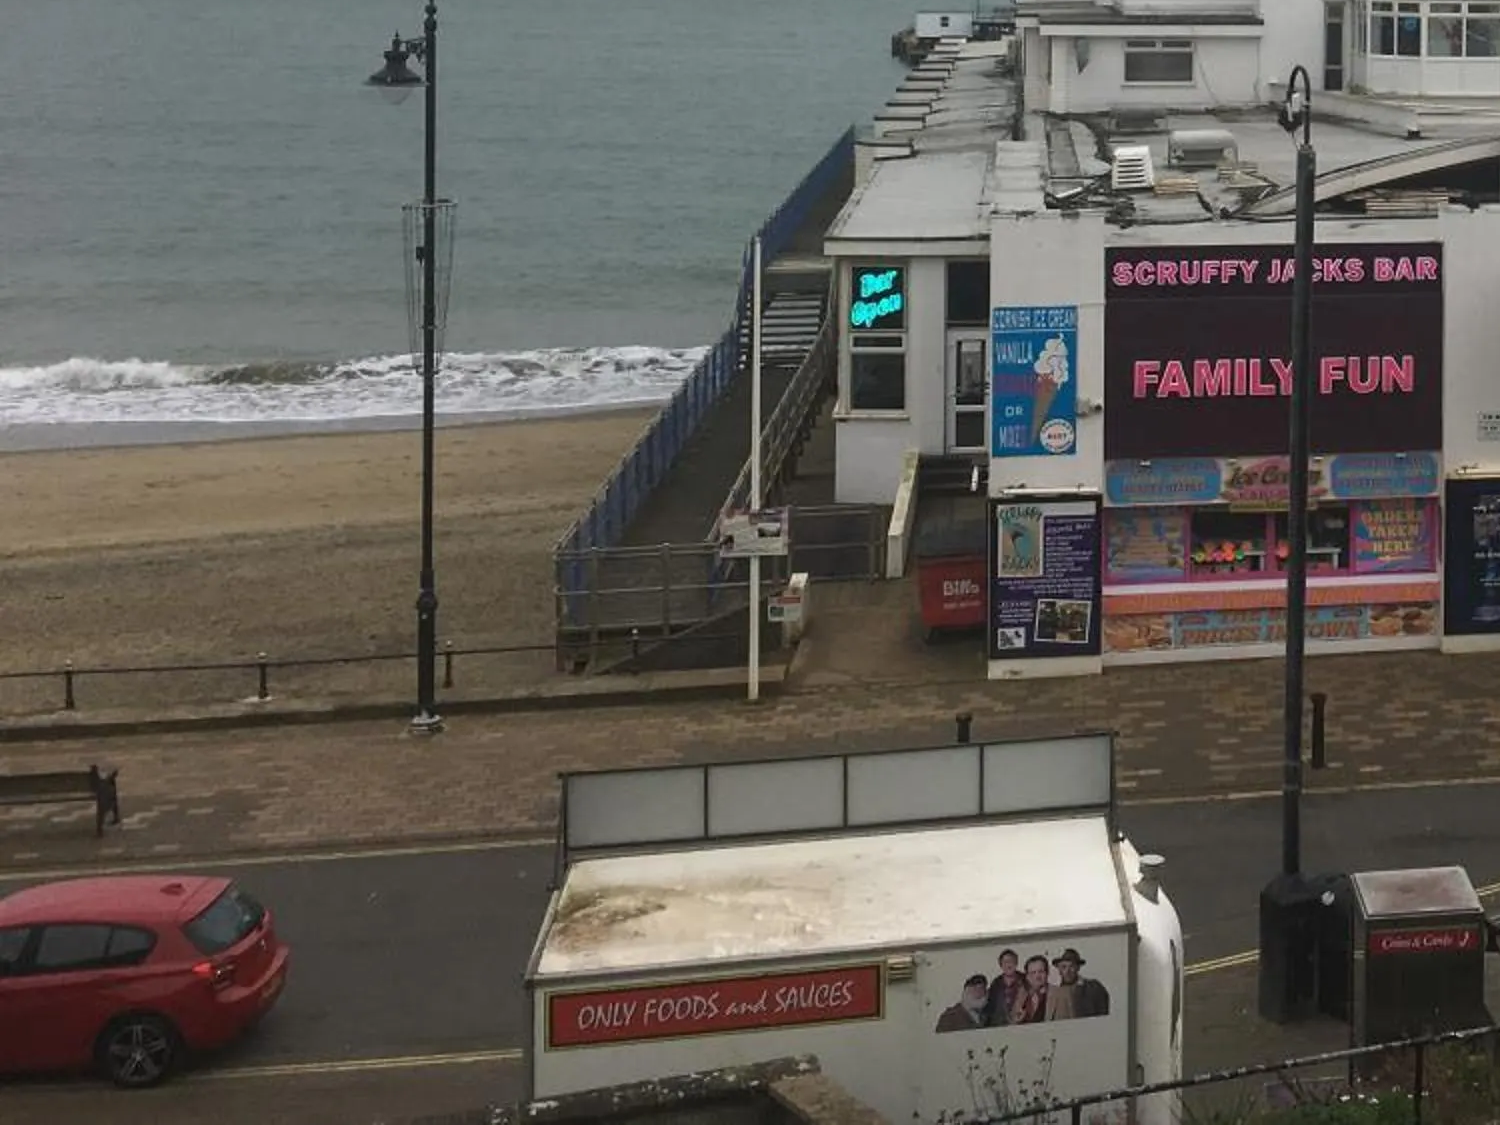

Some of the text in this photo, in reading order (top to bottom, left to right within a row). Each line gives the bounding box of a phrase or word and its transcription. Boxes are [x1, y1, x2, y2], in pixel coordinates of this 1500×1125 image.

[1112, 260, 1259, 286] SCRUFFY
[1374, 256, 1438, 282] BAR
[850, 293, 902, 328] Open
[1133, 355, 1416, 398] FAMILY FUN
[1004, 405, 1025, 418] OR
[577, 980, 853, 1030] ONLY FOODS and SAUCES
